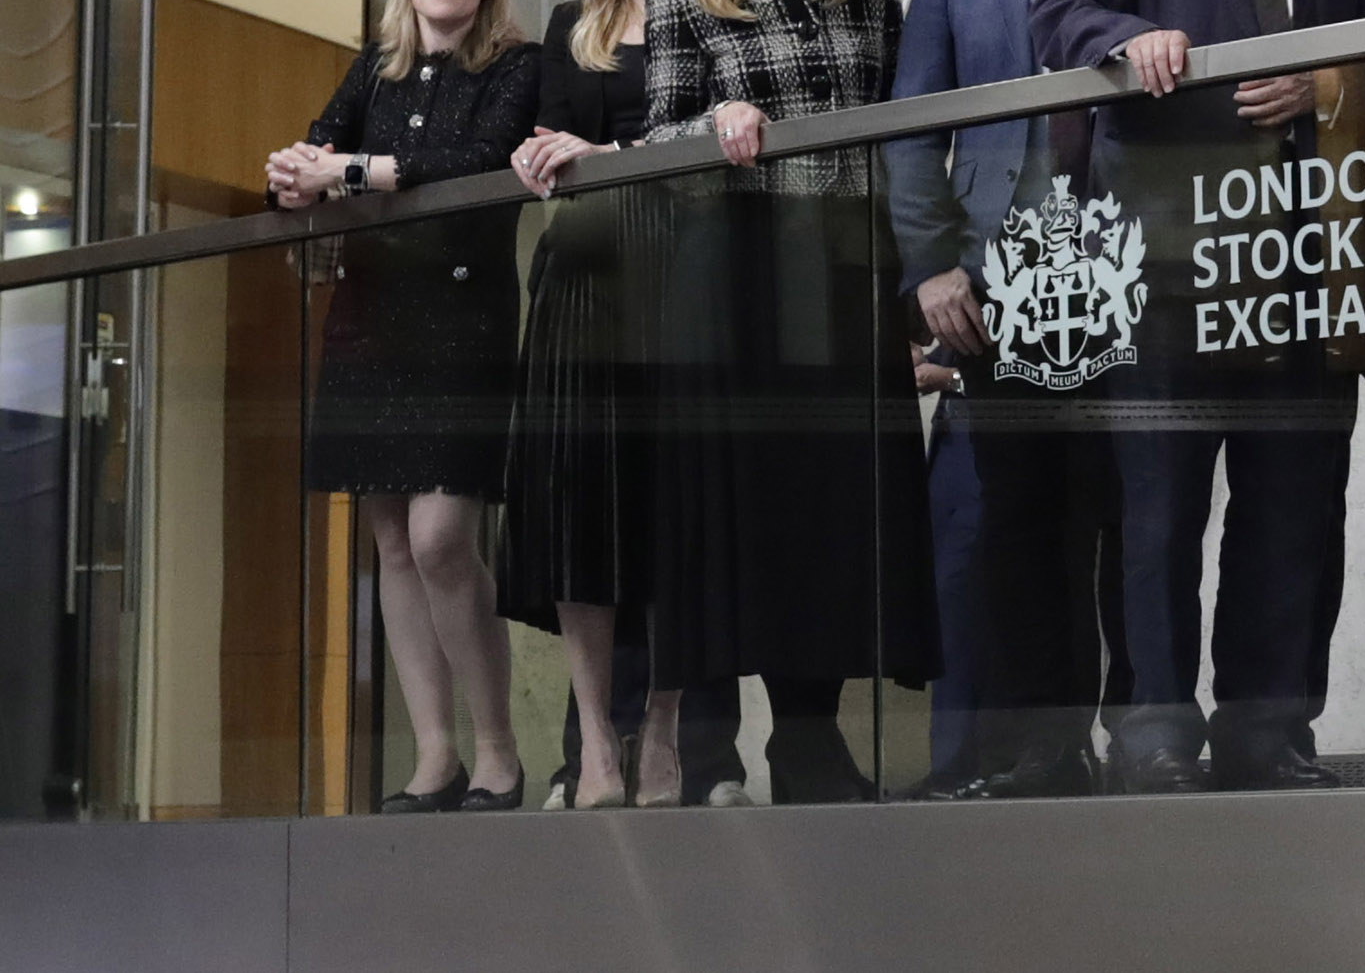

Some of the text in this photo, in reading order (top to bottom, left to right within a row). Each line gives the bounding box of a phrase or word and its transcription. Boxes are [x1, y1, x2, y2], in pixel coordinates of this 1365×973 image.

[1192, 217, 1365, 289] STOCK
[999, 349, 1133, 387] DICTUM MEUM PACTUM
